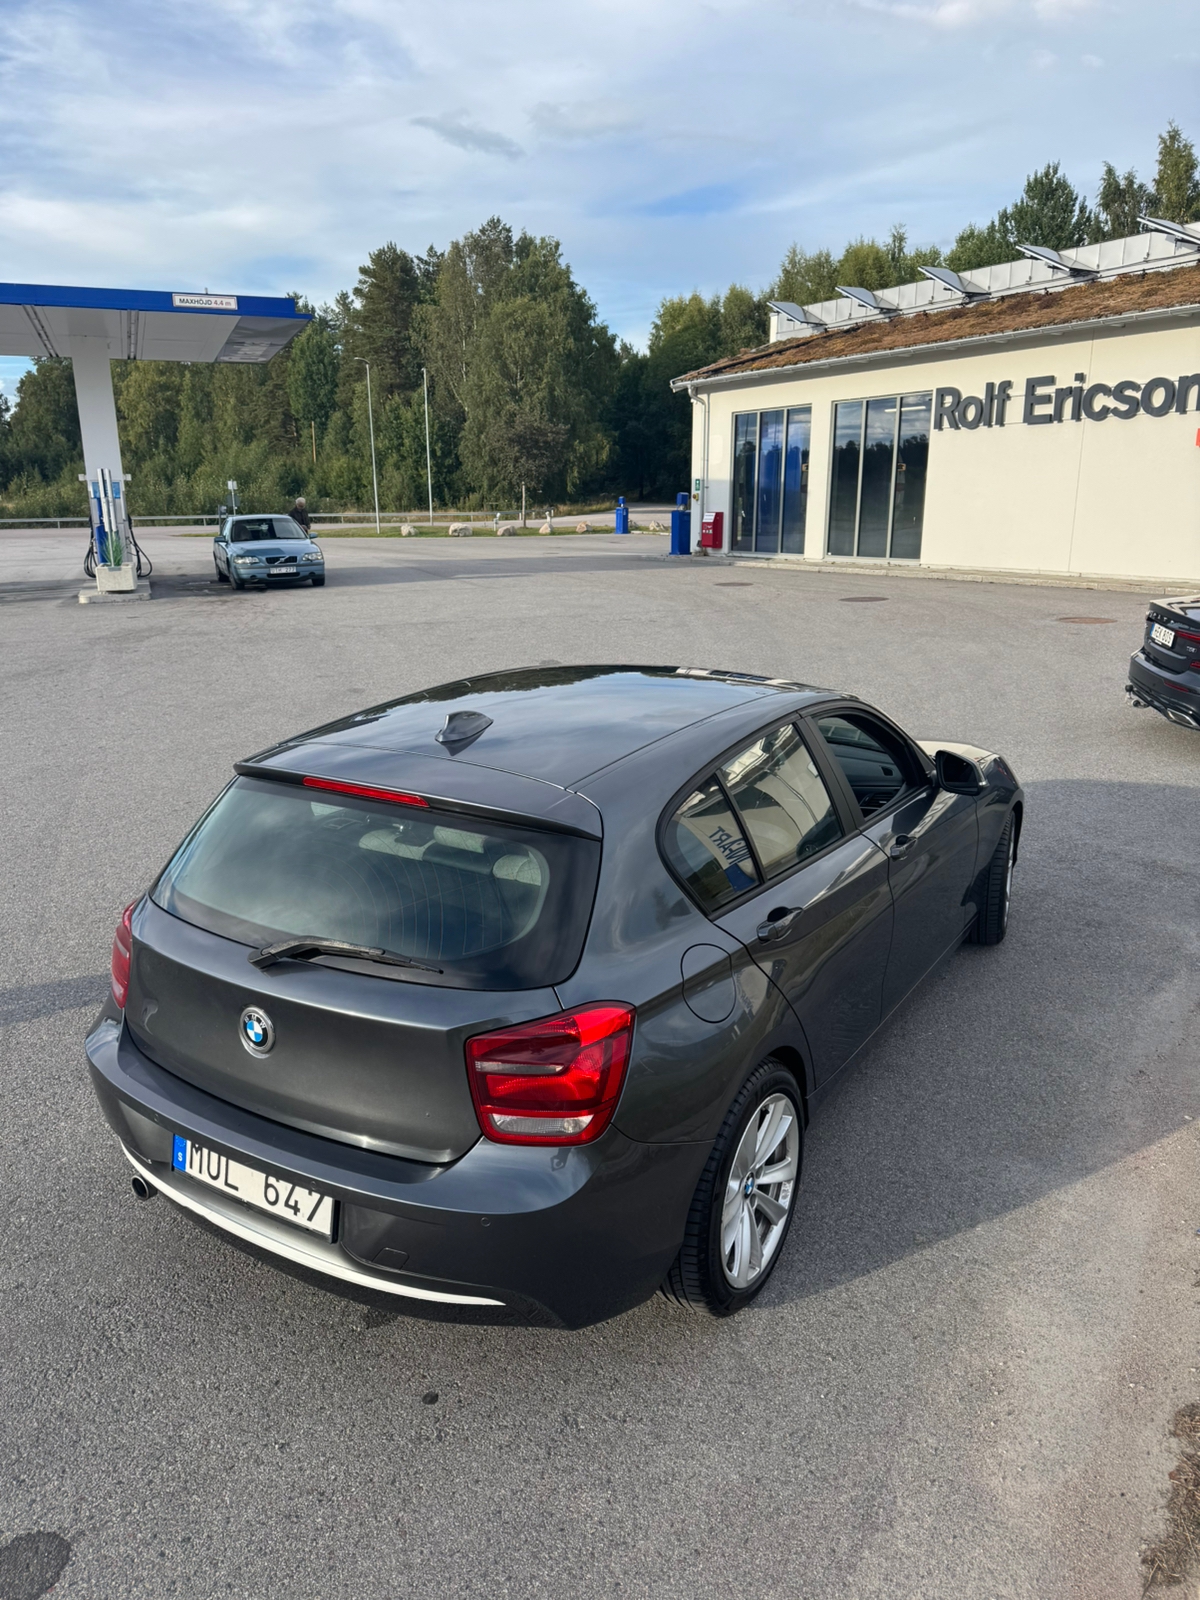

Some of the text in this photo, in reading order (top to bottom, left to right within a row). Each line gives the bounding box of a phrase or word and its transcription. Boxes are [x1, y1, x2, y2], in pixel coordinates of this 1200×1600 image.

[179, 297, 212, 306] MAXHÖJD
[933, 372, 1200, 431] Rolf Ericson
[189, 1141, 326, 1223] MUL 647
